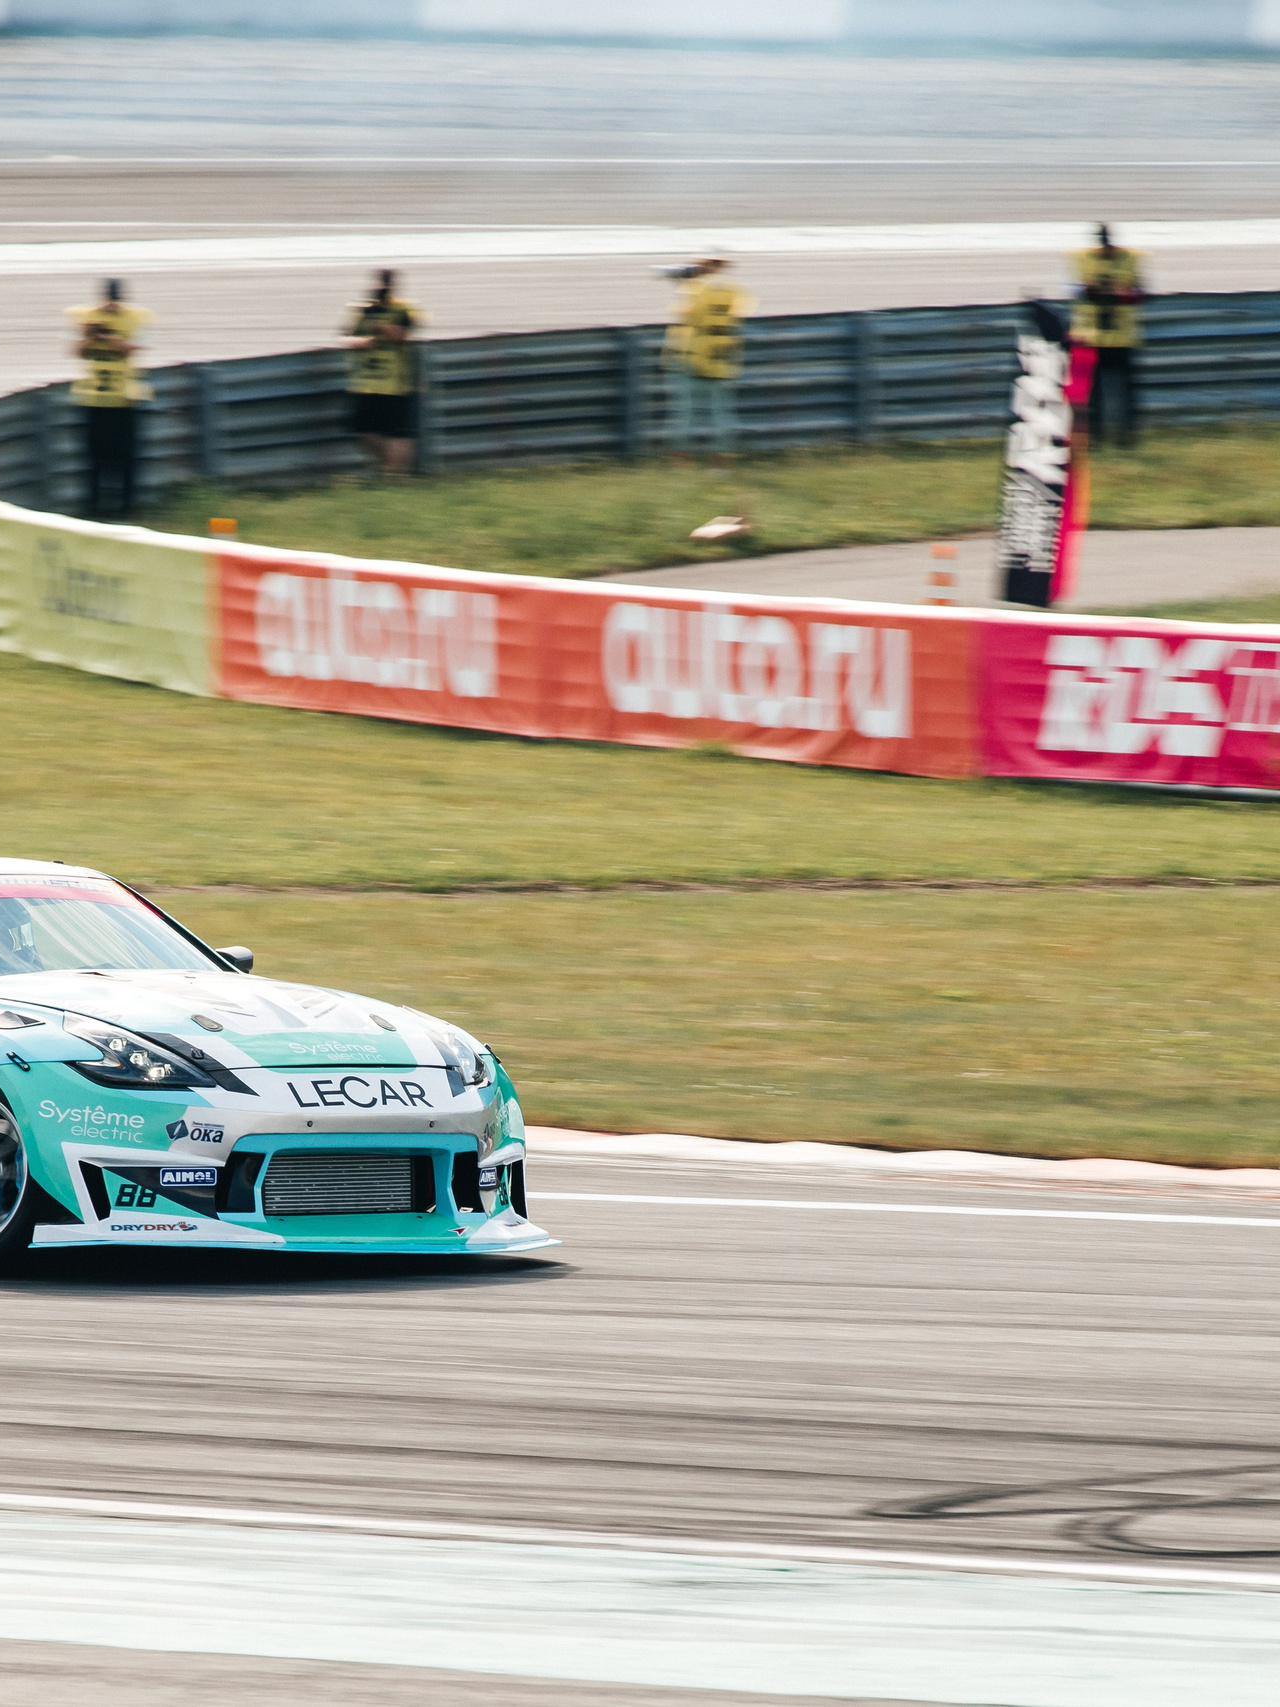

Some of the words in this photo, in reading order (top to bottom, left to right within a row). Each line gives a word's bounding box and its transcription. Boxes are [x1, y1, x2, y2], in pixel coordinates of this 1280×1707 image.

[288, 1041, 378, 1055] Systême
[327, 1053, 386, 1062] electric
[287, 1076, 434, 1108] LECAR
[38, 1100, 145, 1129] Systême
[71, 1122, 144, 1144] electric
[163, 1171, 214, 1183] AIMOL
